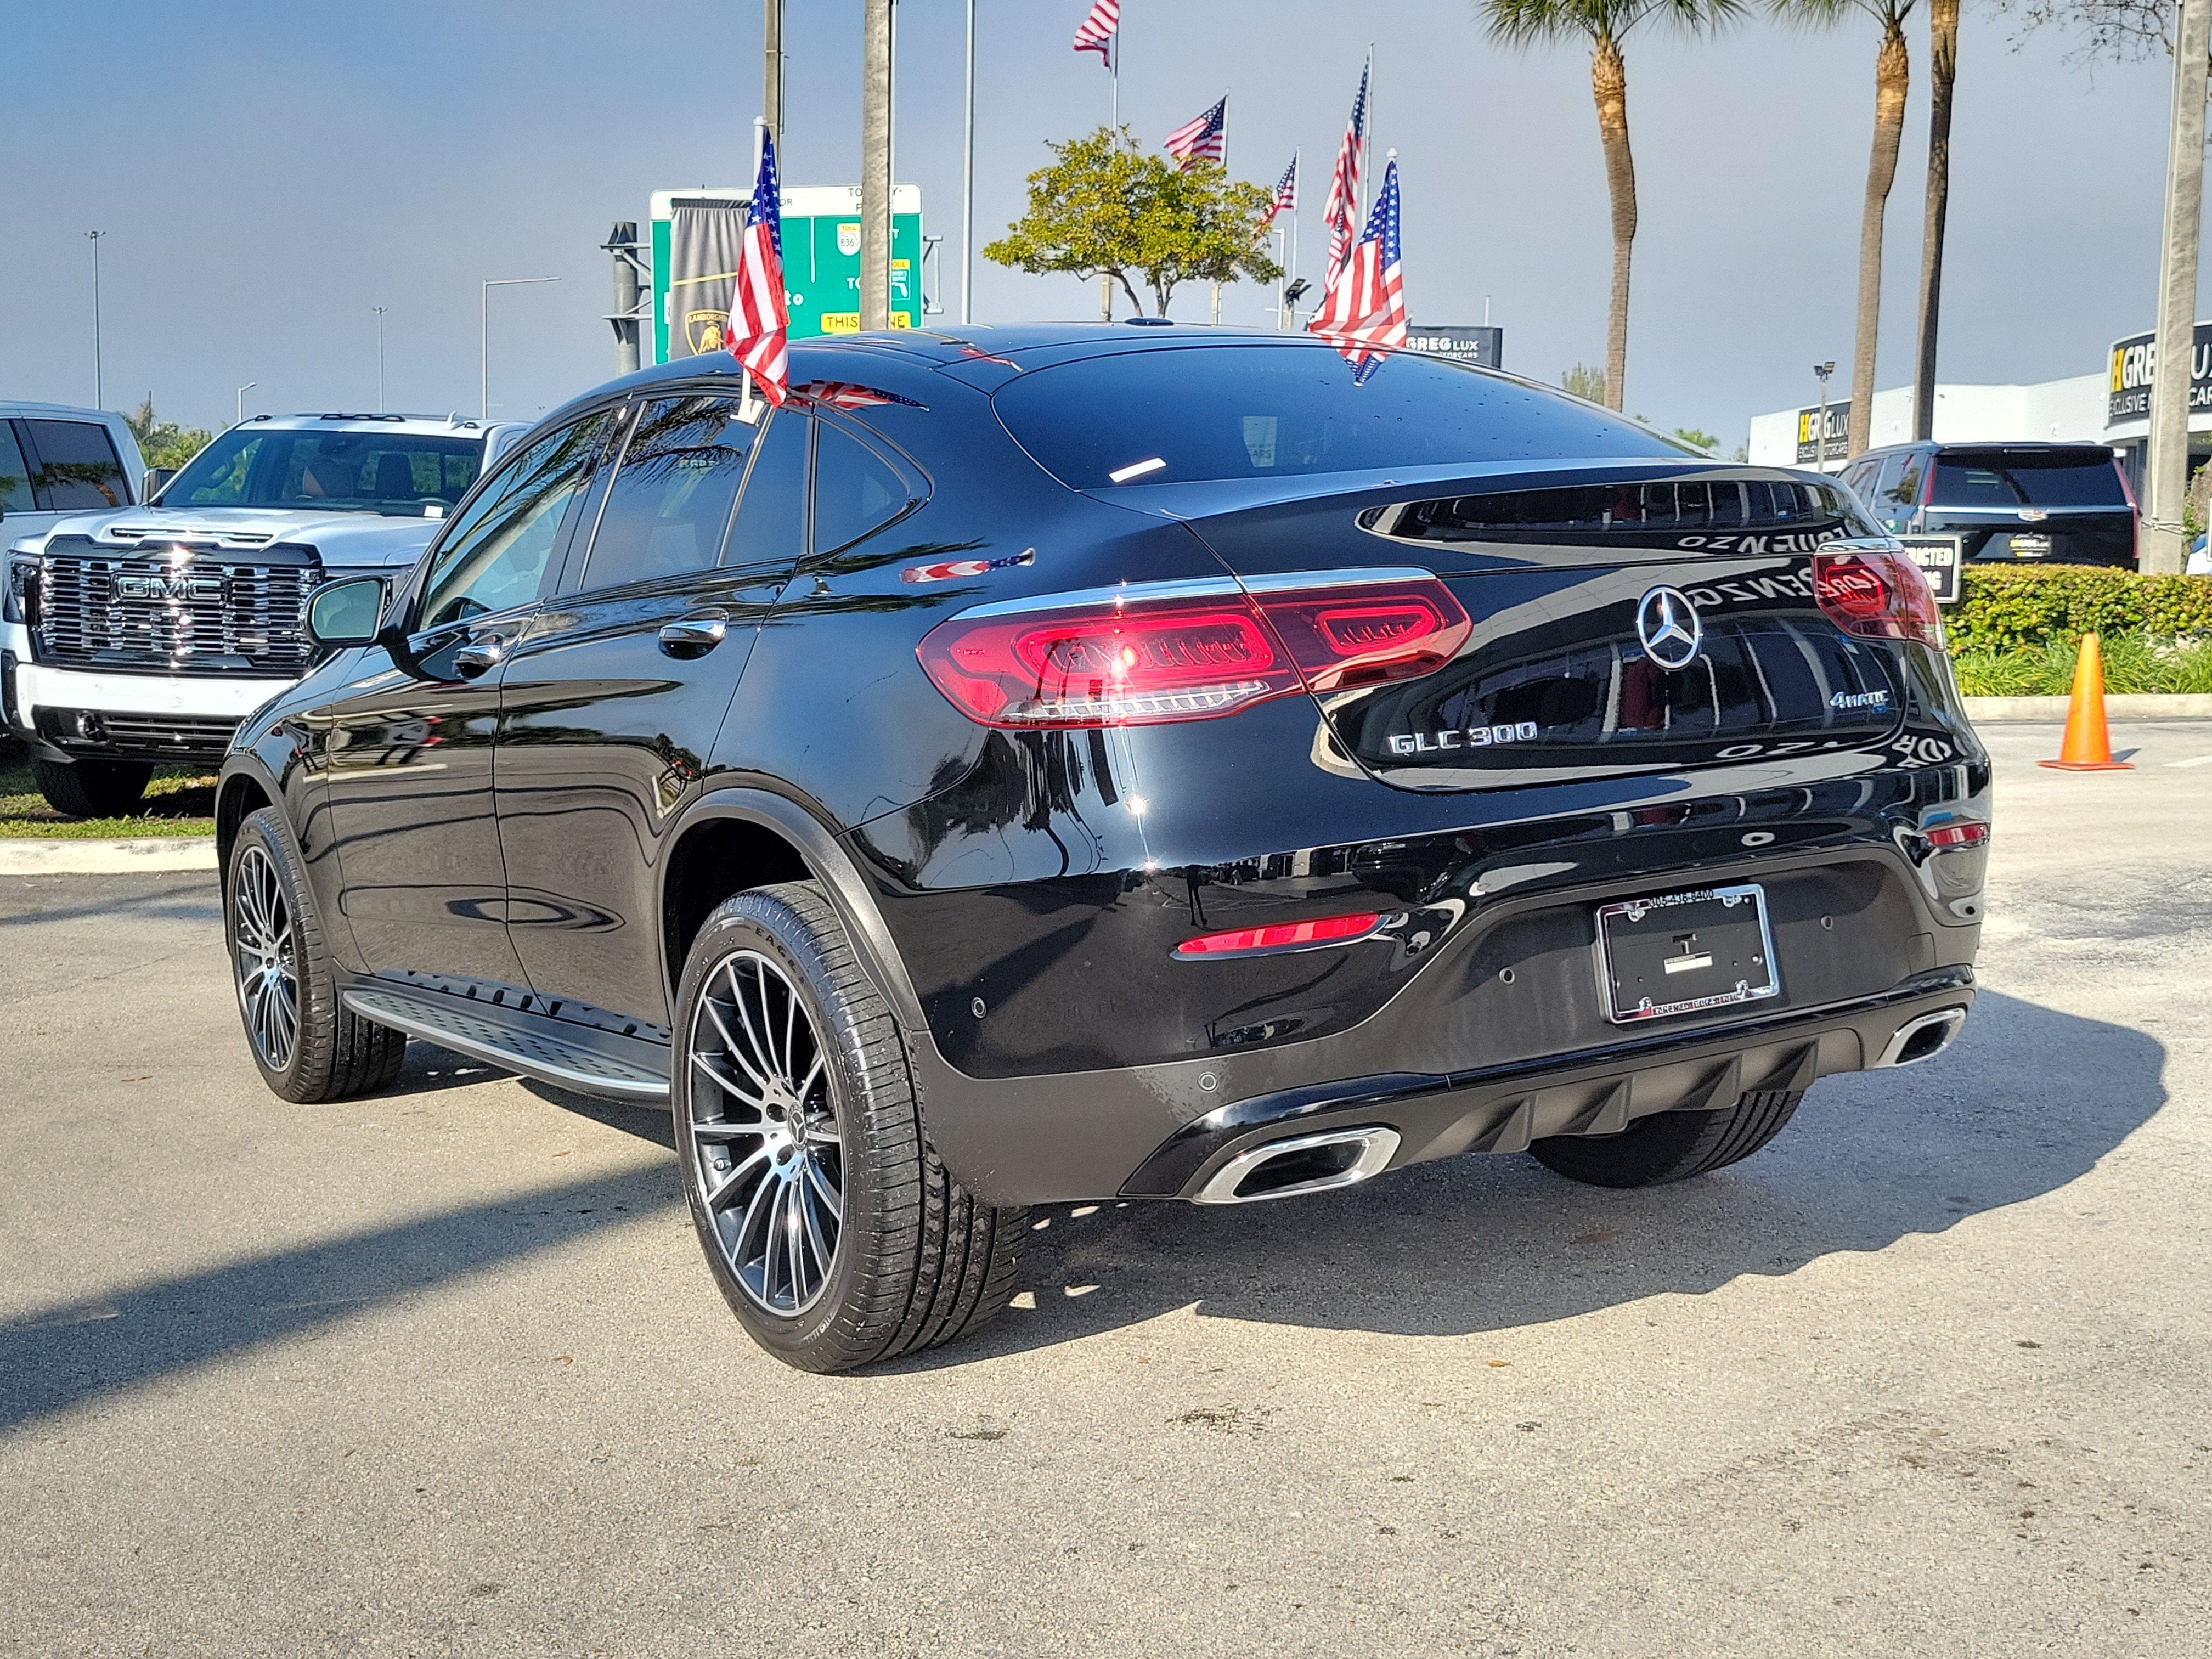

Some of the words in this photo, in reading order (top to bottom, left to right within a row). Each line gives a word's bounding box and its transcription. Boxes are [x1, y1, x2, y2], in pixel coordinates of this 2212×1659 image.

[827, 316, 858, 328] THIS
[1453, 340, 1480, 351] LUX
[2111, 342, 2157, 393] HGRE
[1799, 410, 1831, 443] HGRG
[1904, 546, 1953, 566] RICTED
[117, 577, 221, 600] GMC
[1389, 730, 1462, 754] GLC
[1468, 721, 1538, 747] 300
